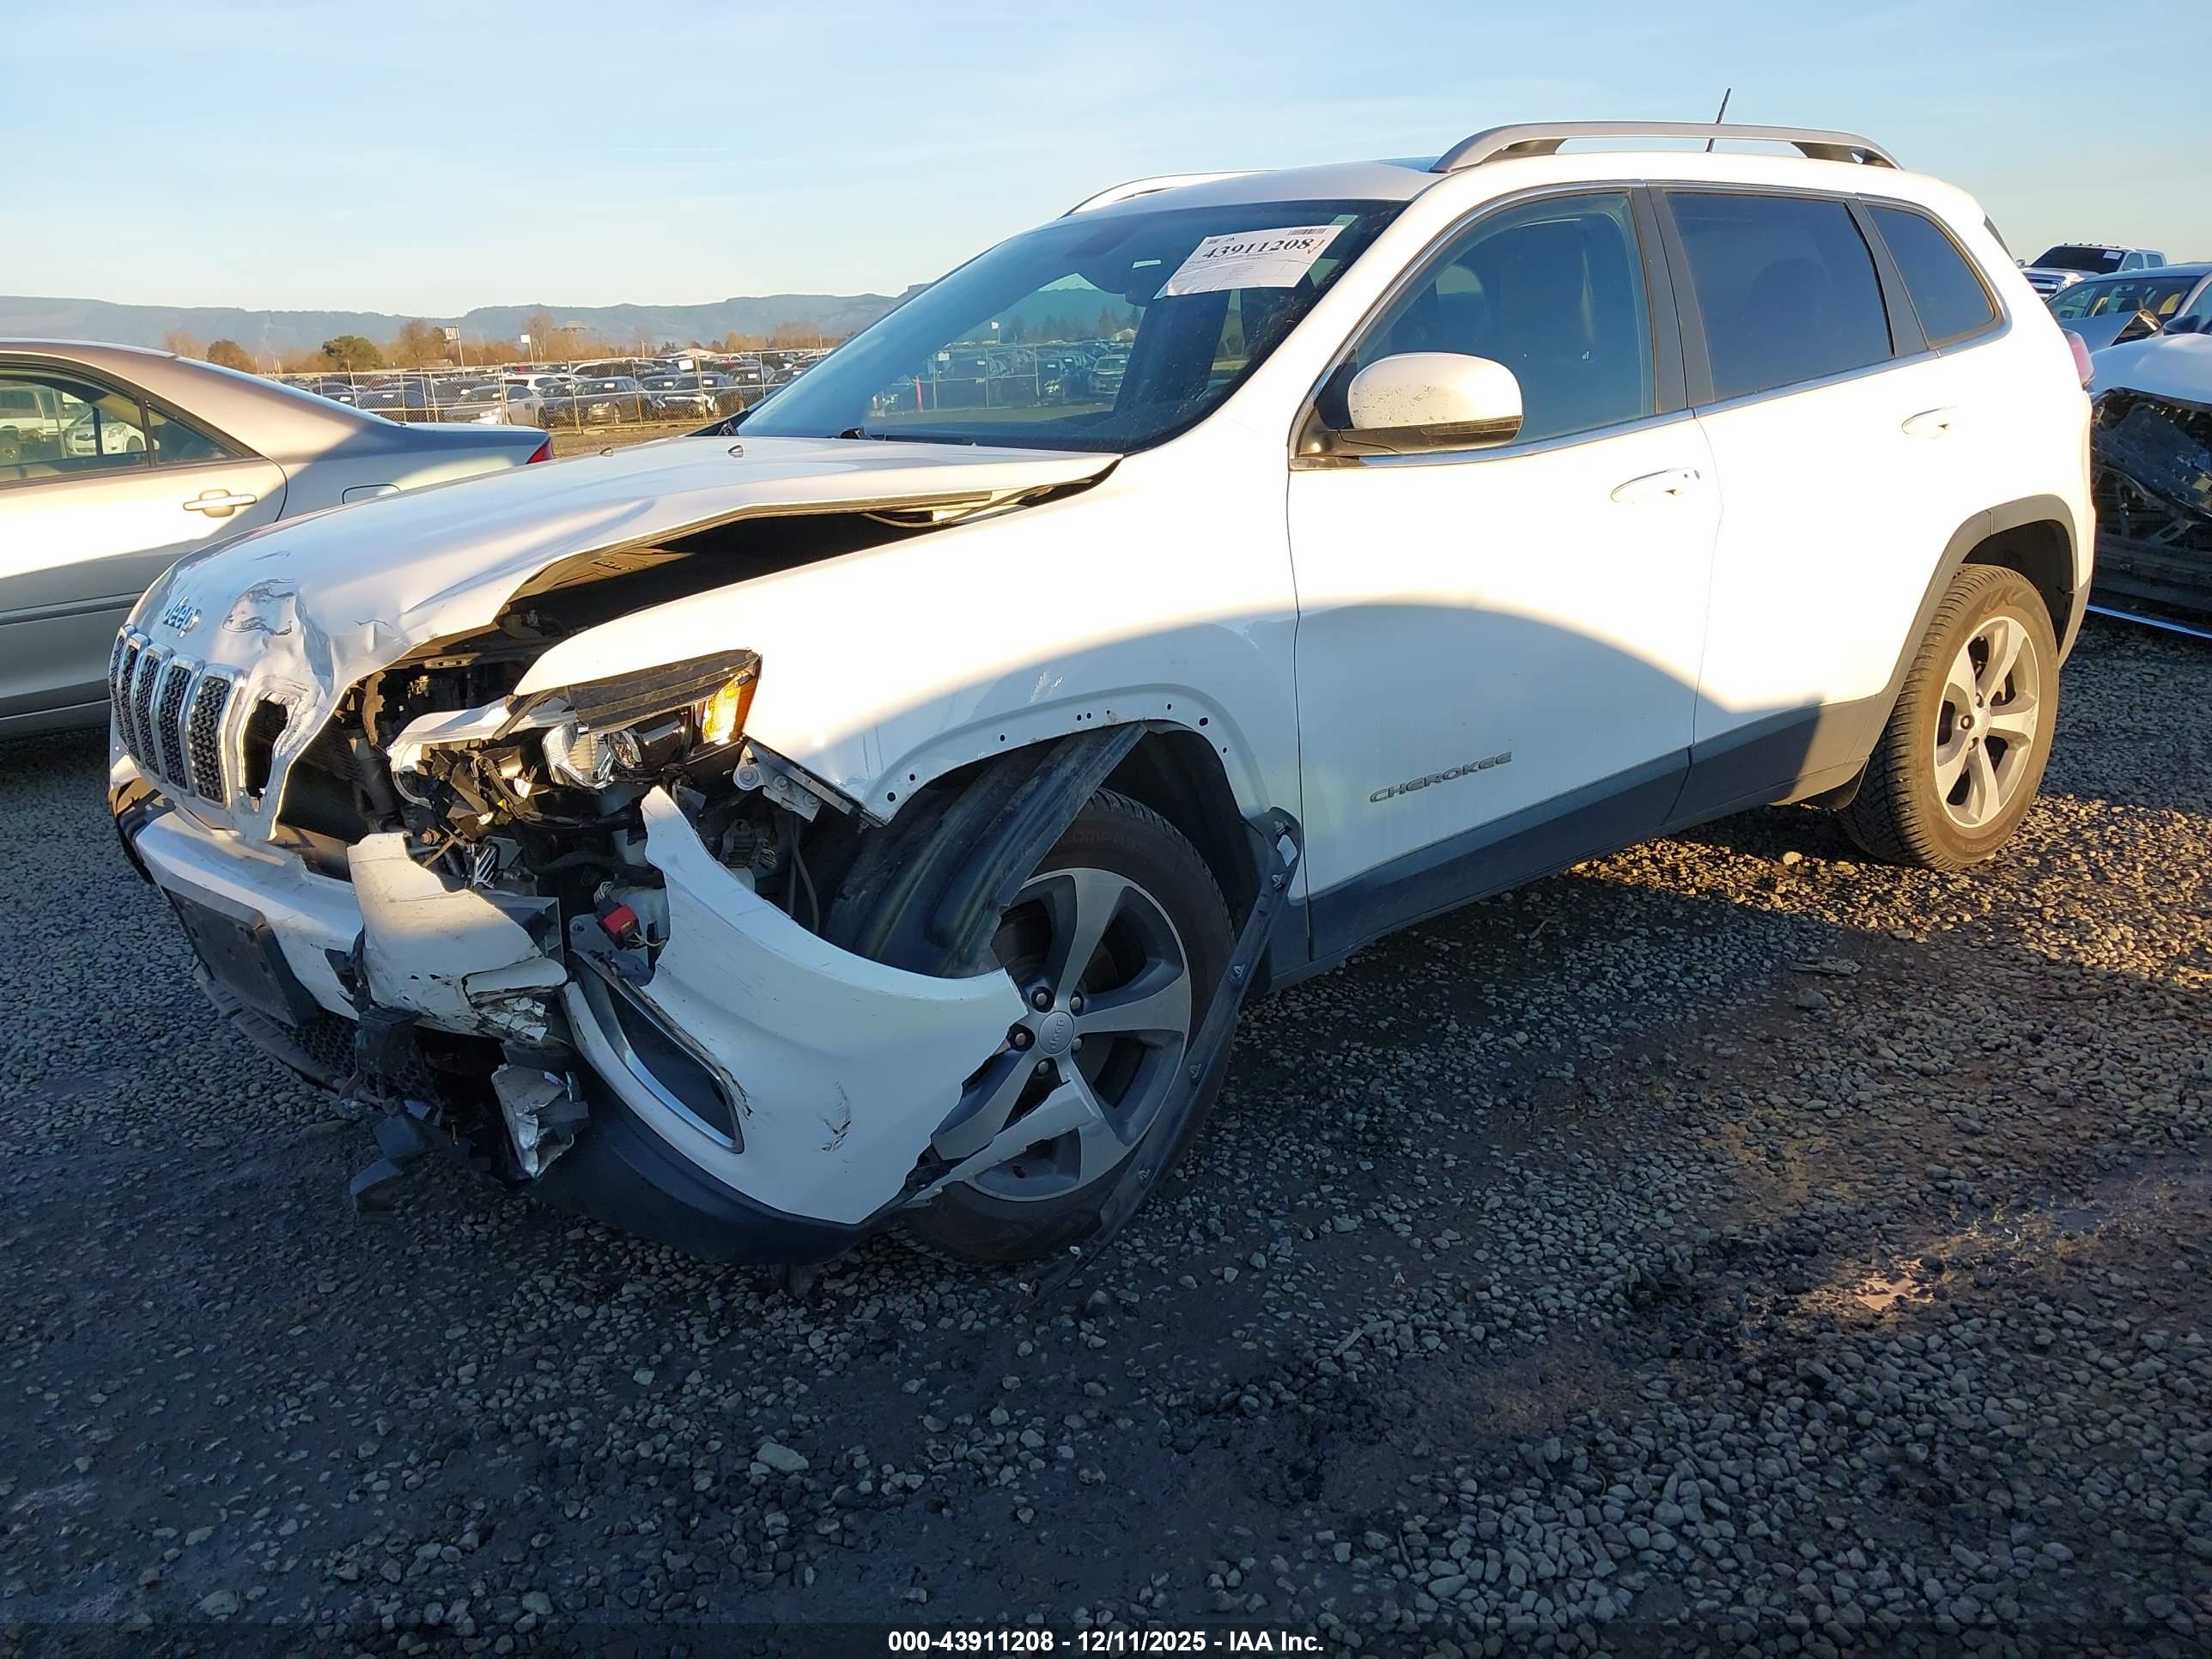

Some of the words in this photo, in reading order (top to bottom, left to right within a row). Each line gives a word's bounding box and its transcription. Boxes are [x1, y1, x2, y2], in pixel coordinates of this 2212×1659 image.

[1201, 238, 1314, 259] 43911208
[165, 596, 200, 637] Jeep
[1369, 751, 1512, 804] CHEROKEE
[1049, 1018, 1066, 1051] Jeep
